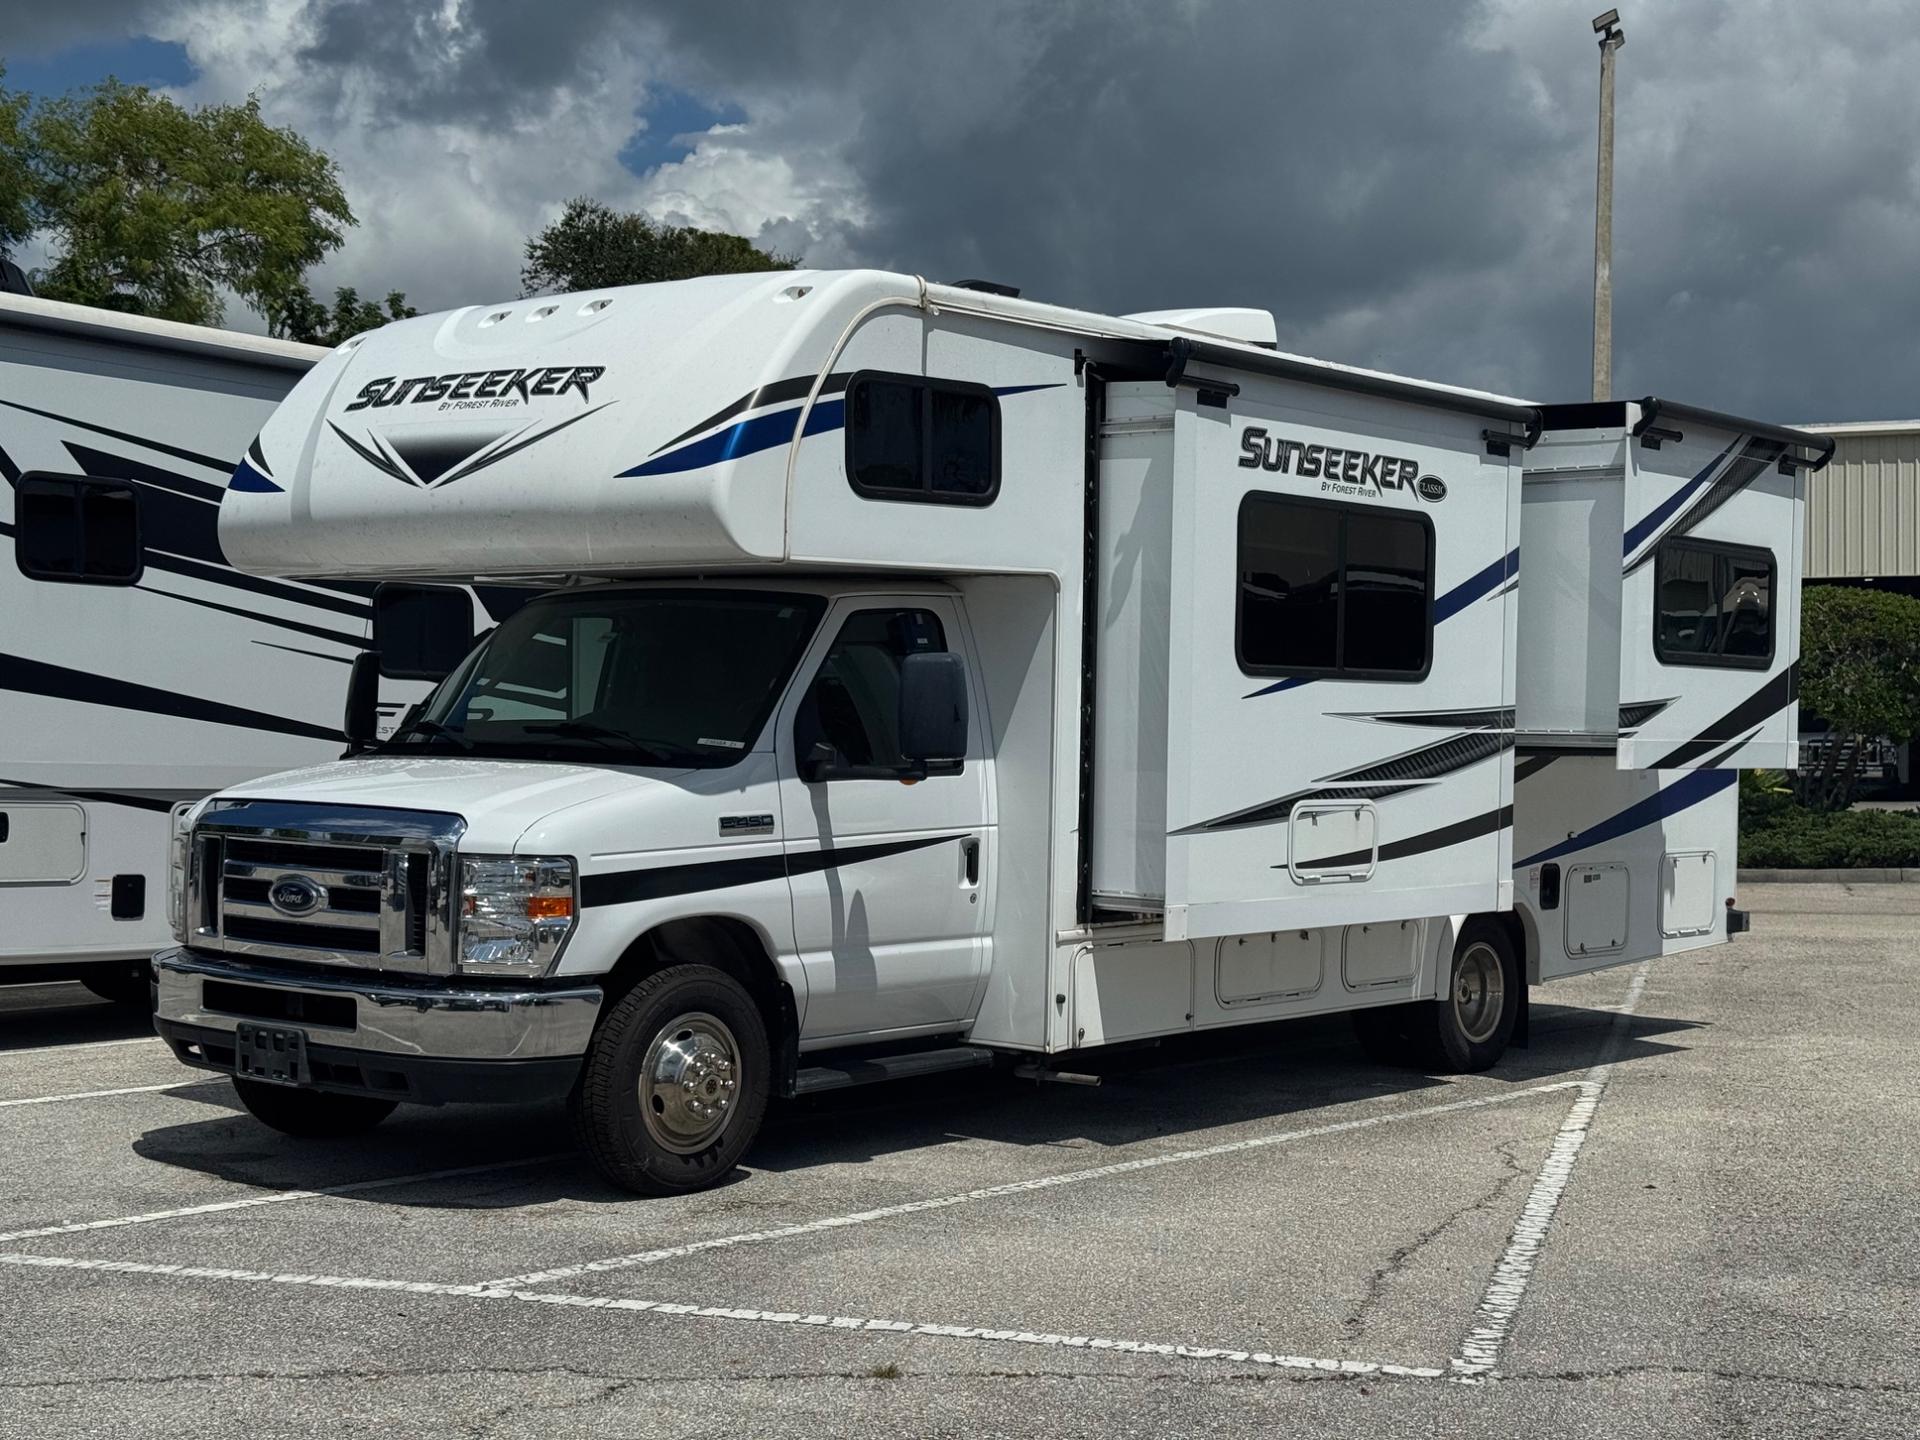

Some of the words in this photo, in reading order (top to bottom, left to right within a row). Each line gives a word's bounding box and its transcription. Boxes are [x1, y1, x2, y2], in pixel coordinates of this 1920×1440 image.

[344, 366, 606, 412] SUNSEEKER
[453, 400, 489, 410] FOREST
[490, 399, 518, 408] RIVER
[1238, 427, 1419, 502] SUNSEEKER
[1332, 483, 1357, 495] FOREST
[1358, 486, 1376, 498] RIVER
[1419, 480, 1446, 495] CLASSIC
[279, 887, 303, 903] Ford
